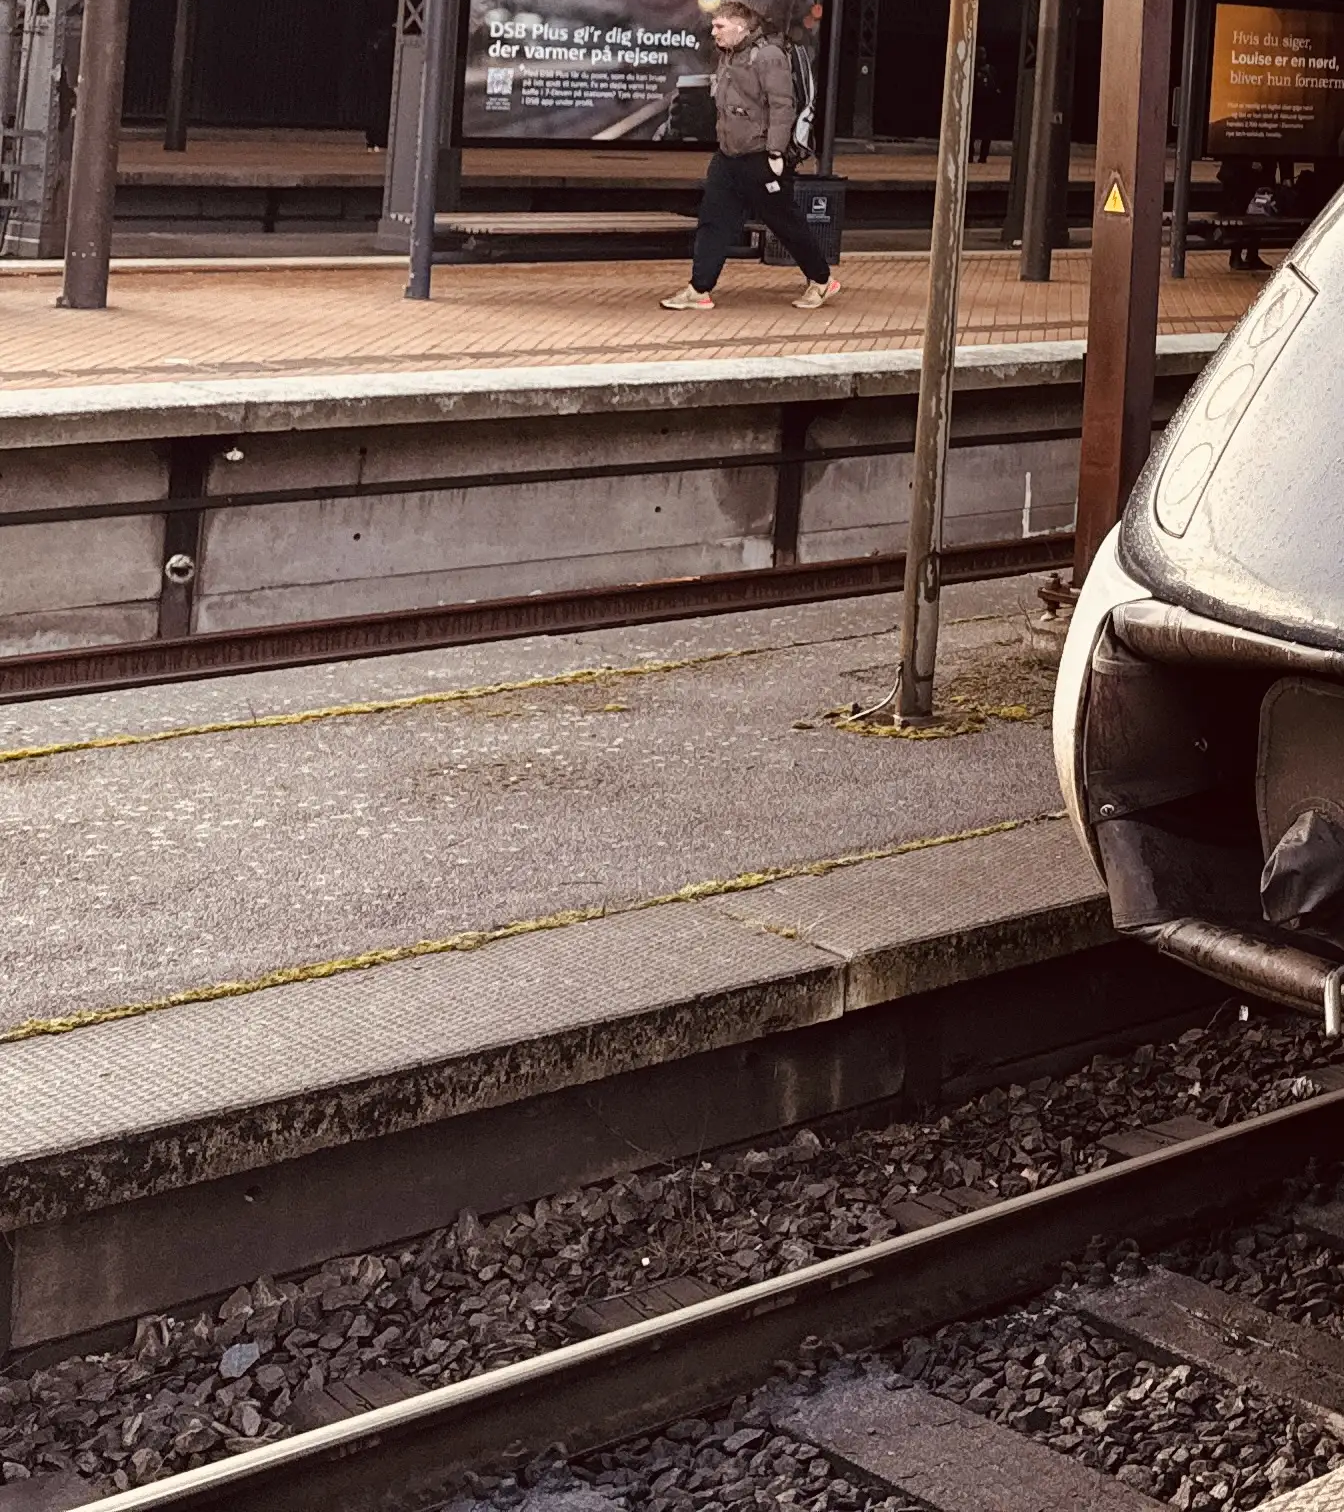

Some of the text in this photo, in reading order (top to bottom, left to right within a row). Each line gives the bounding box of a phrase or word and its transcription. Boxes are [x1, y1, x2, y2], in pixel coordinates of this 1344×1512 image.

[490, 21, 526, 38] DSB
[532, 22, 568, 41] Plus
[606, 27, 632, 47] dig
[636, 27, 700, 50] fordele,
[1232, 30, 1313, 51] Hvis du siger,
[488, 40, 669, 67] der varmer på rejsen
[1231, 51, 1340, 71] Louise er en nørd,
[1230, 71, 1263, 86] bliver
[1267, 72, 1291, 87] hun
